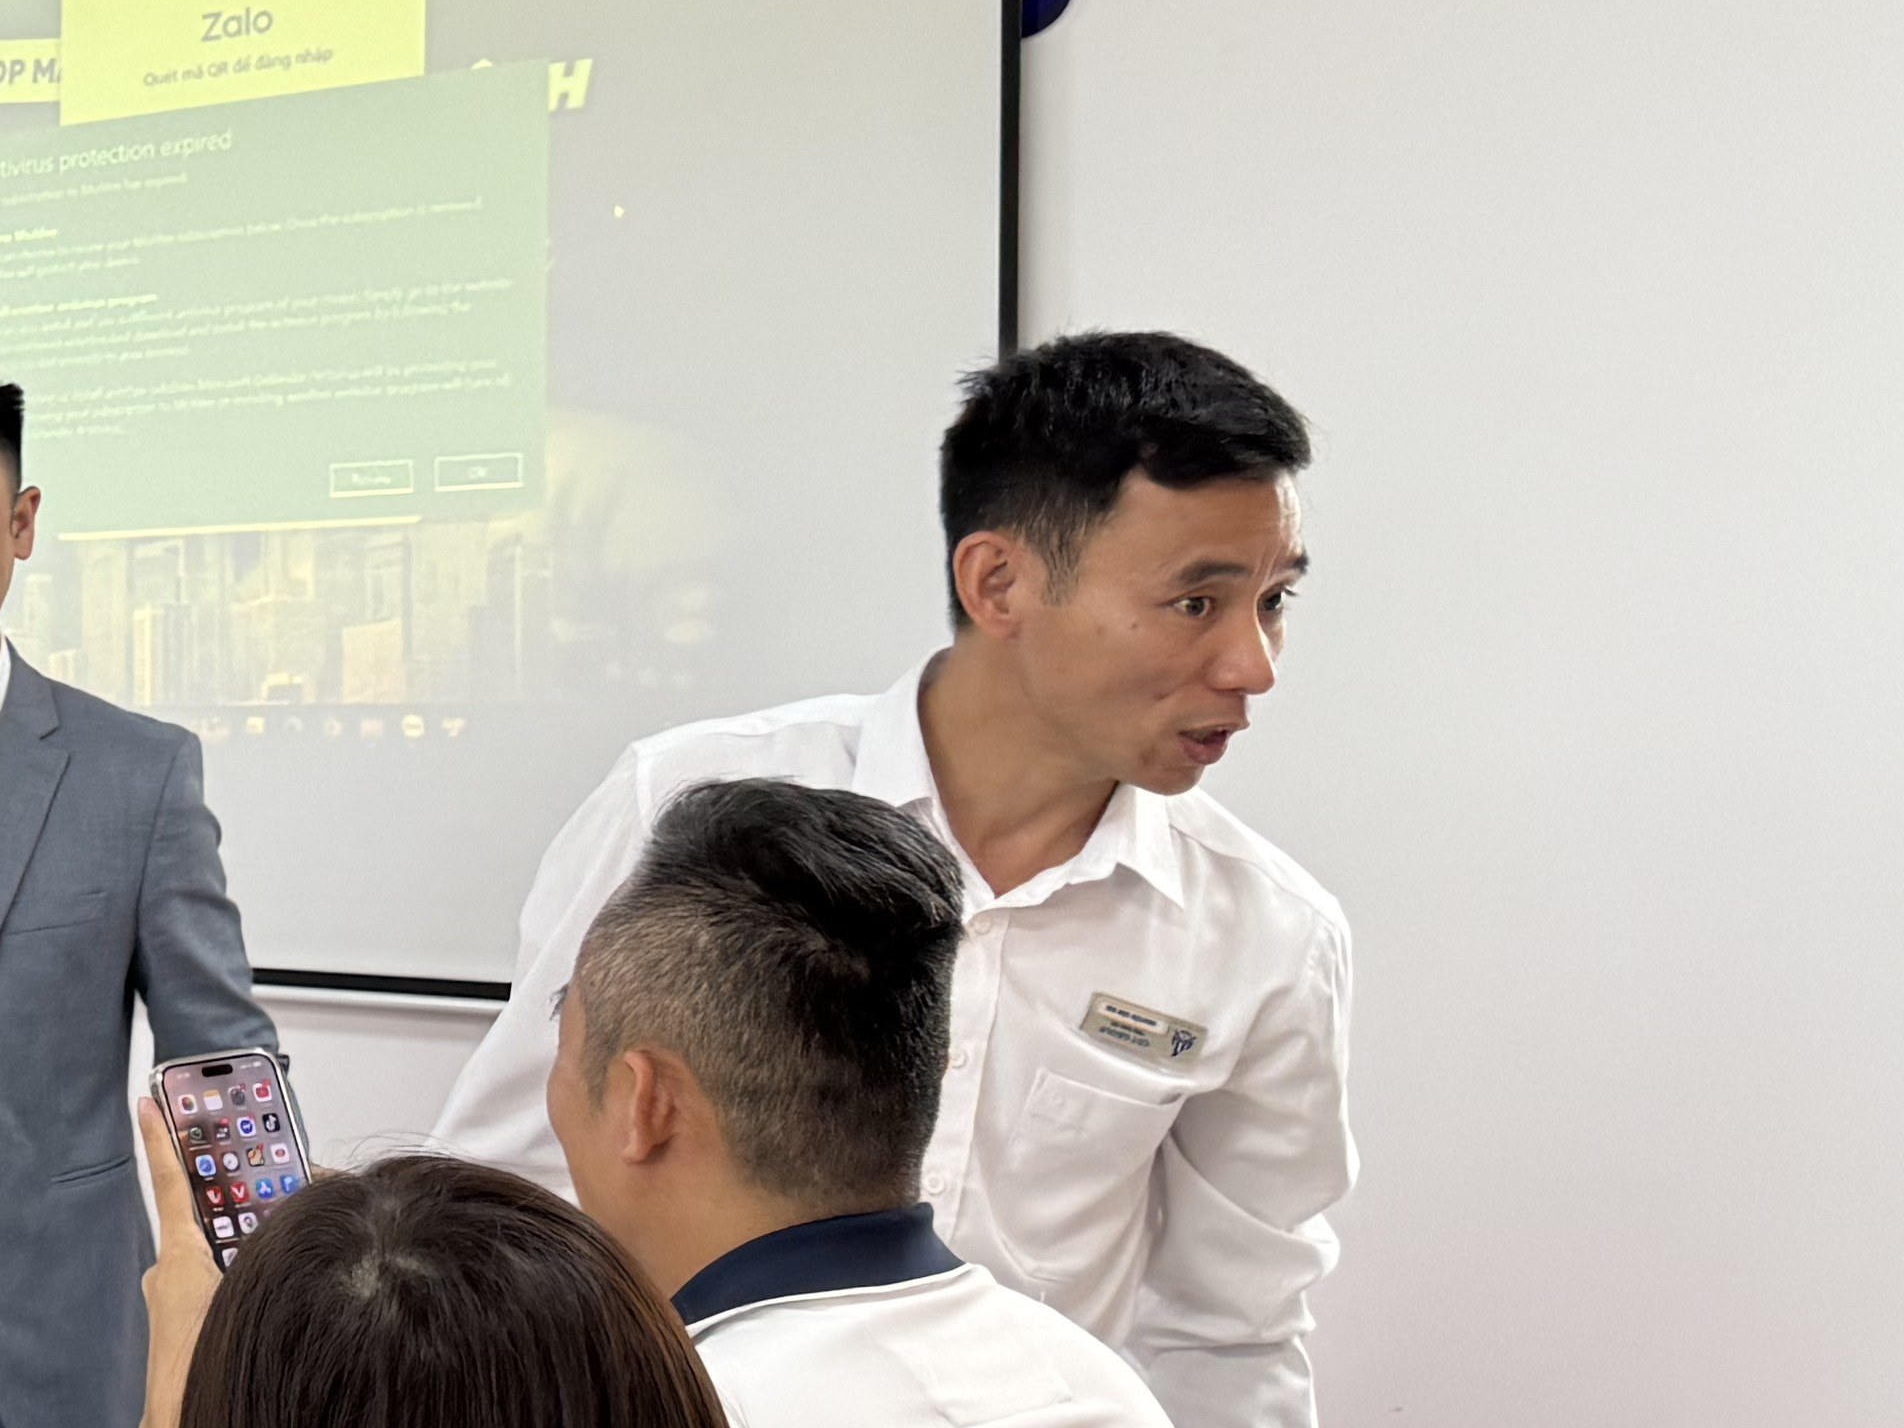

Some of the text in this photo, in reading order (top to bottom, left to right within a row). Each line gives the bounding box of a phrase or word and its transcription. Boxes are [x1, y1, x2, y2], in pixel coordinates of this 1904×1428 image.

[201, 6, 274, 42] Zalo
[206, 61, 229, 78] QR
[58, 141, 156, 175] protection
[159, 126, 234, 159] expired
